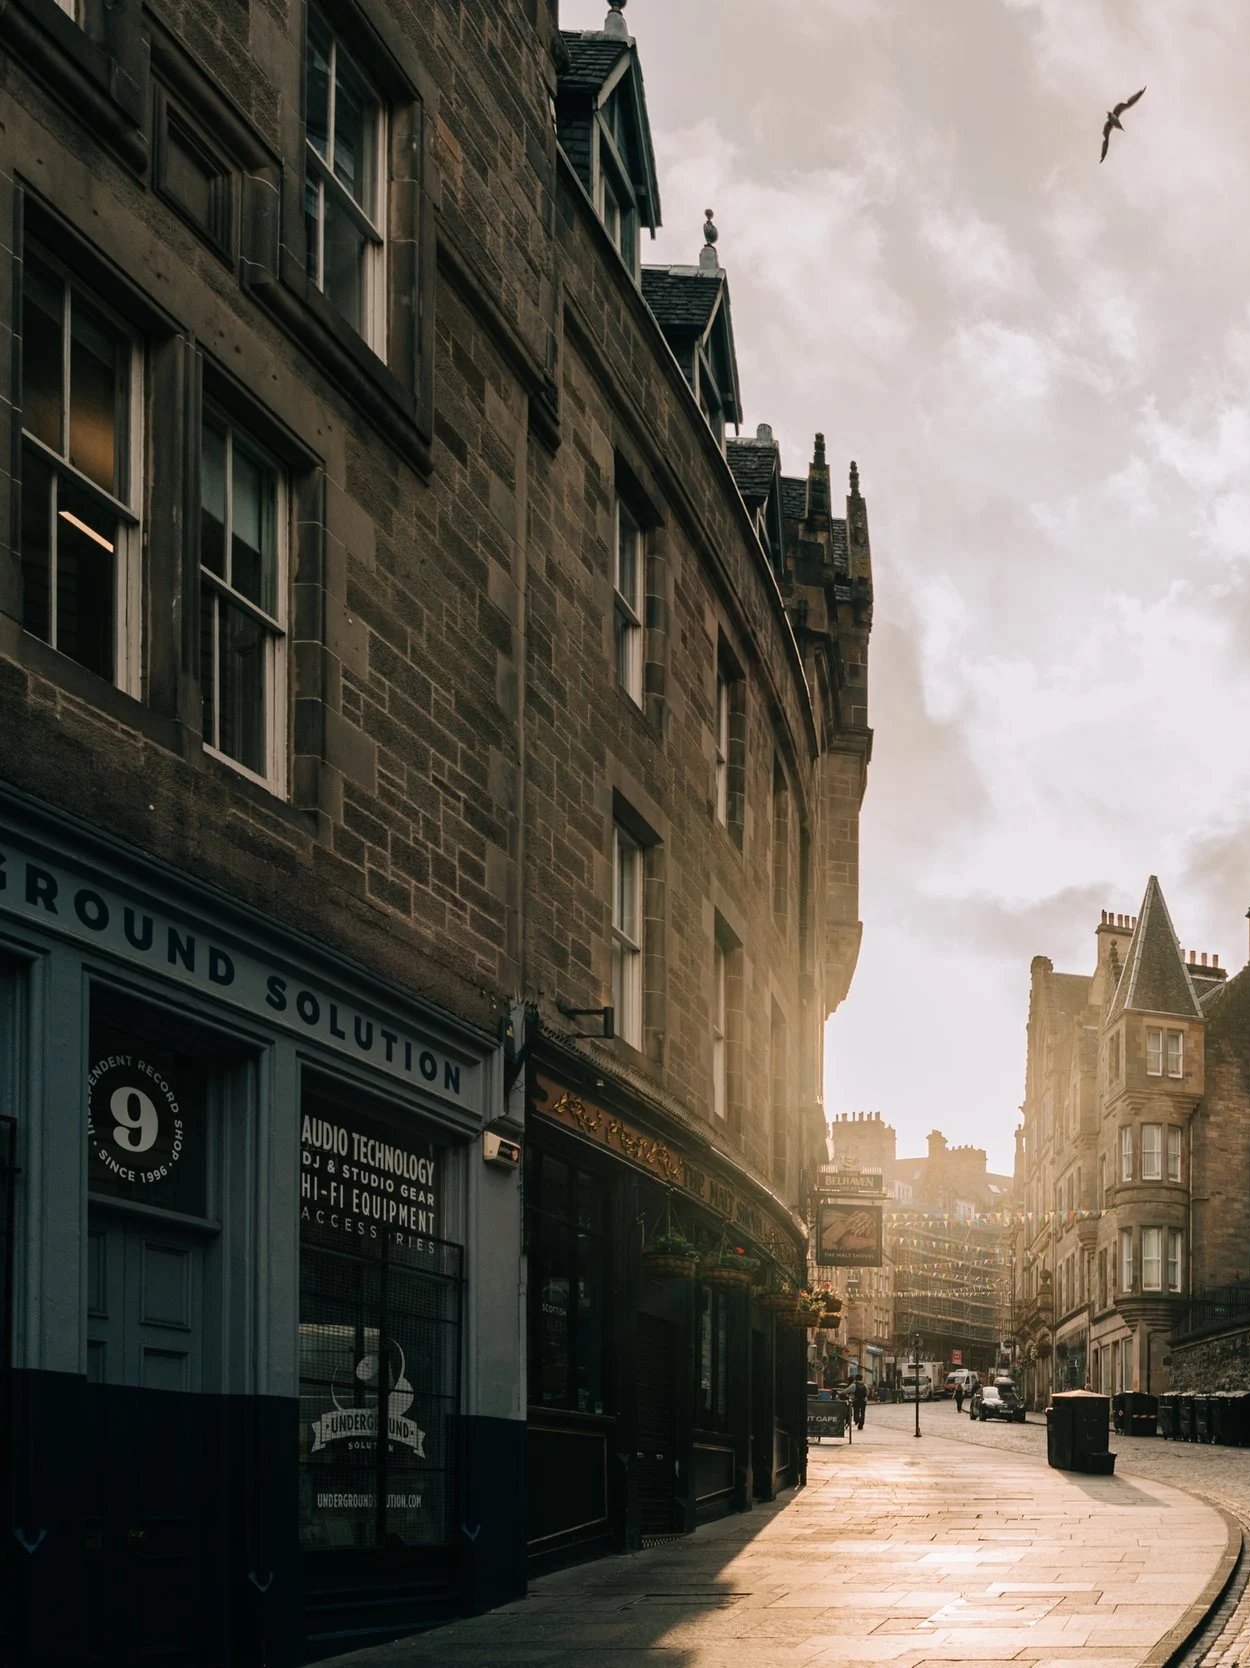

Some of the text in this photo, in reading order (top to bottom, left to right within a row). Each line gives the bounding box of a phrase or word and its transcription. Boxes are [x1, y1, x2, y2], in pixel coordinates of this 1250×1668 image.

[265, 975, 460, 1095] SOLUTION
[110, 1086, 159, 1153] 9
[137, 1058, 179, 1113] RECORD
[171, 1119, 184, 1161] SHOP
[98, 1149, 168, 1183] SINCE 1996
[301, 1114, 435, 1187] AUDIO TECHNOLOGY
[302, 1151, 435, 1206] DJ & STUDIO GEAR
[302, 1172, 435, 1235] HI-FI EQUIPMENT
[825, 1175, 874, 1187] BELHAVEN
[301, 1205, 435, 1254] ACCESSRIES
[331, 1414, 409, 1438] UNDERGUND
[348, 1441, 394, 1453] SOLUTN
